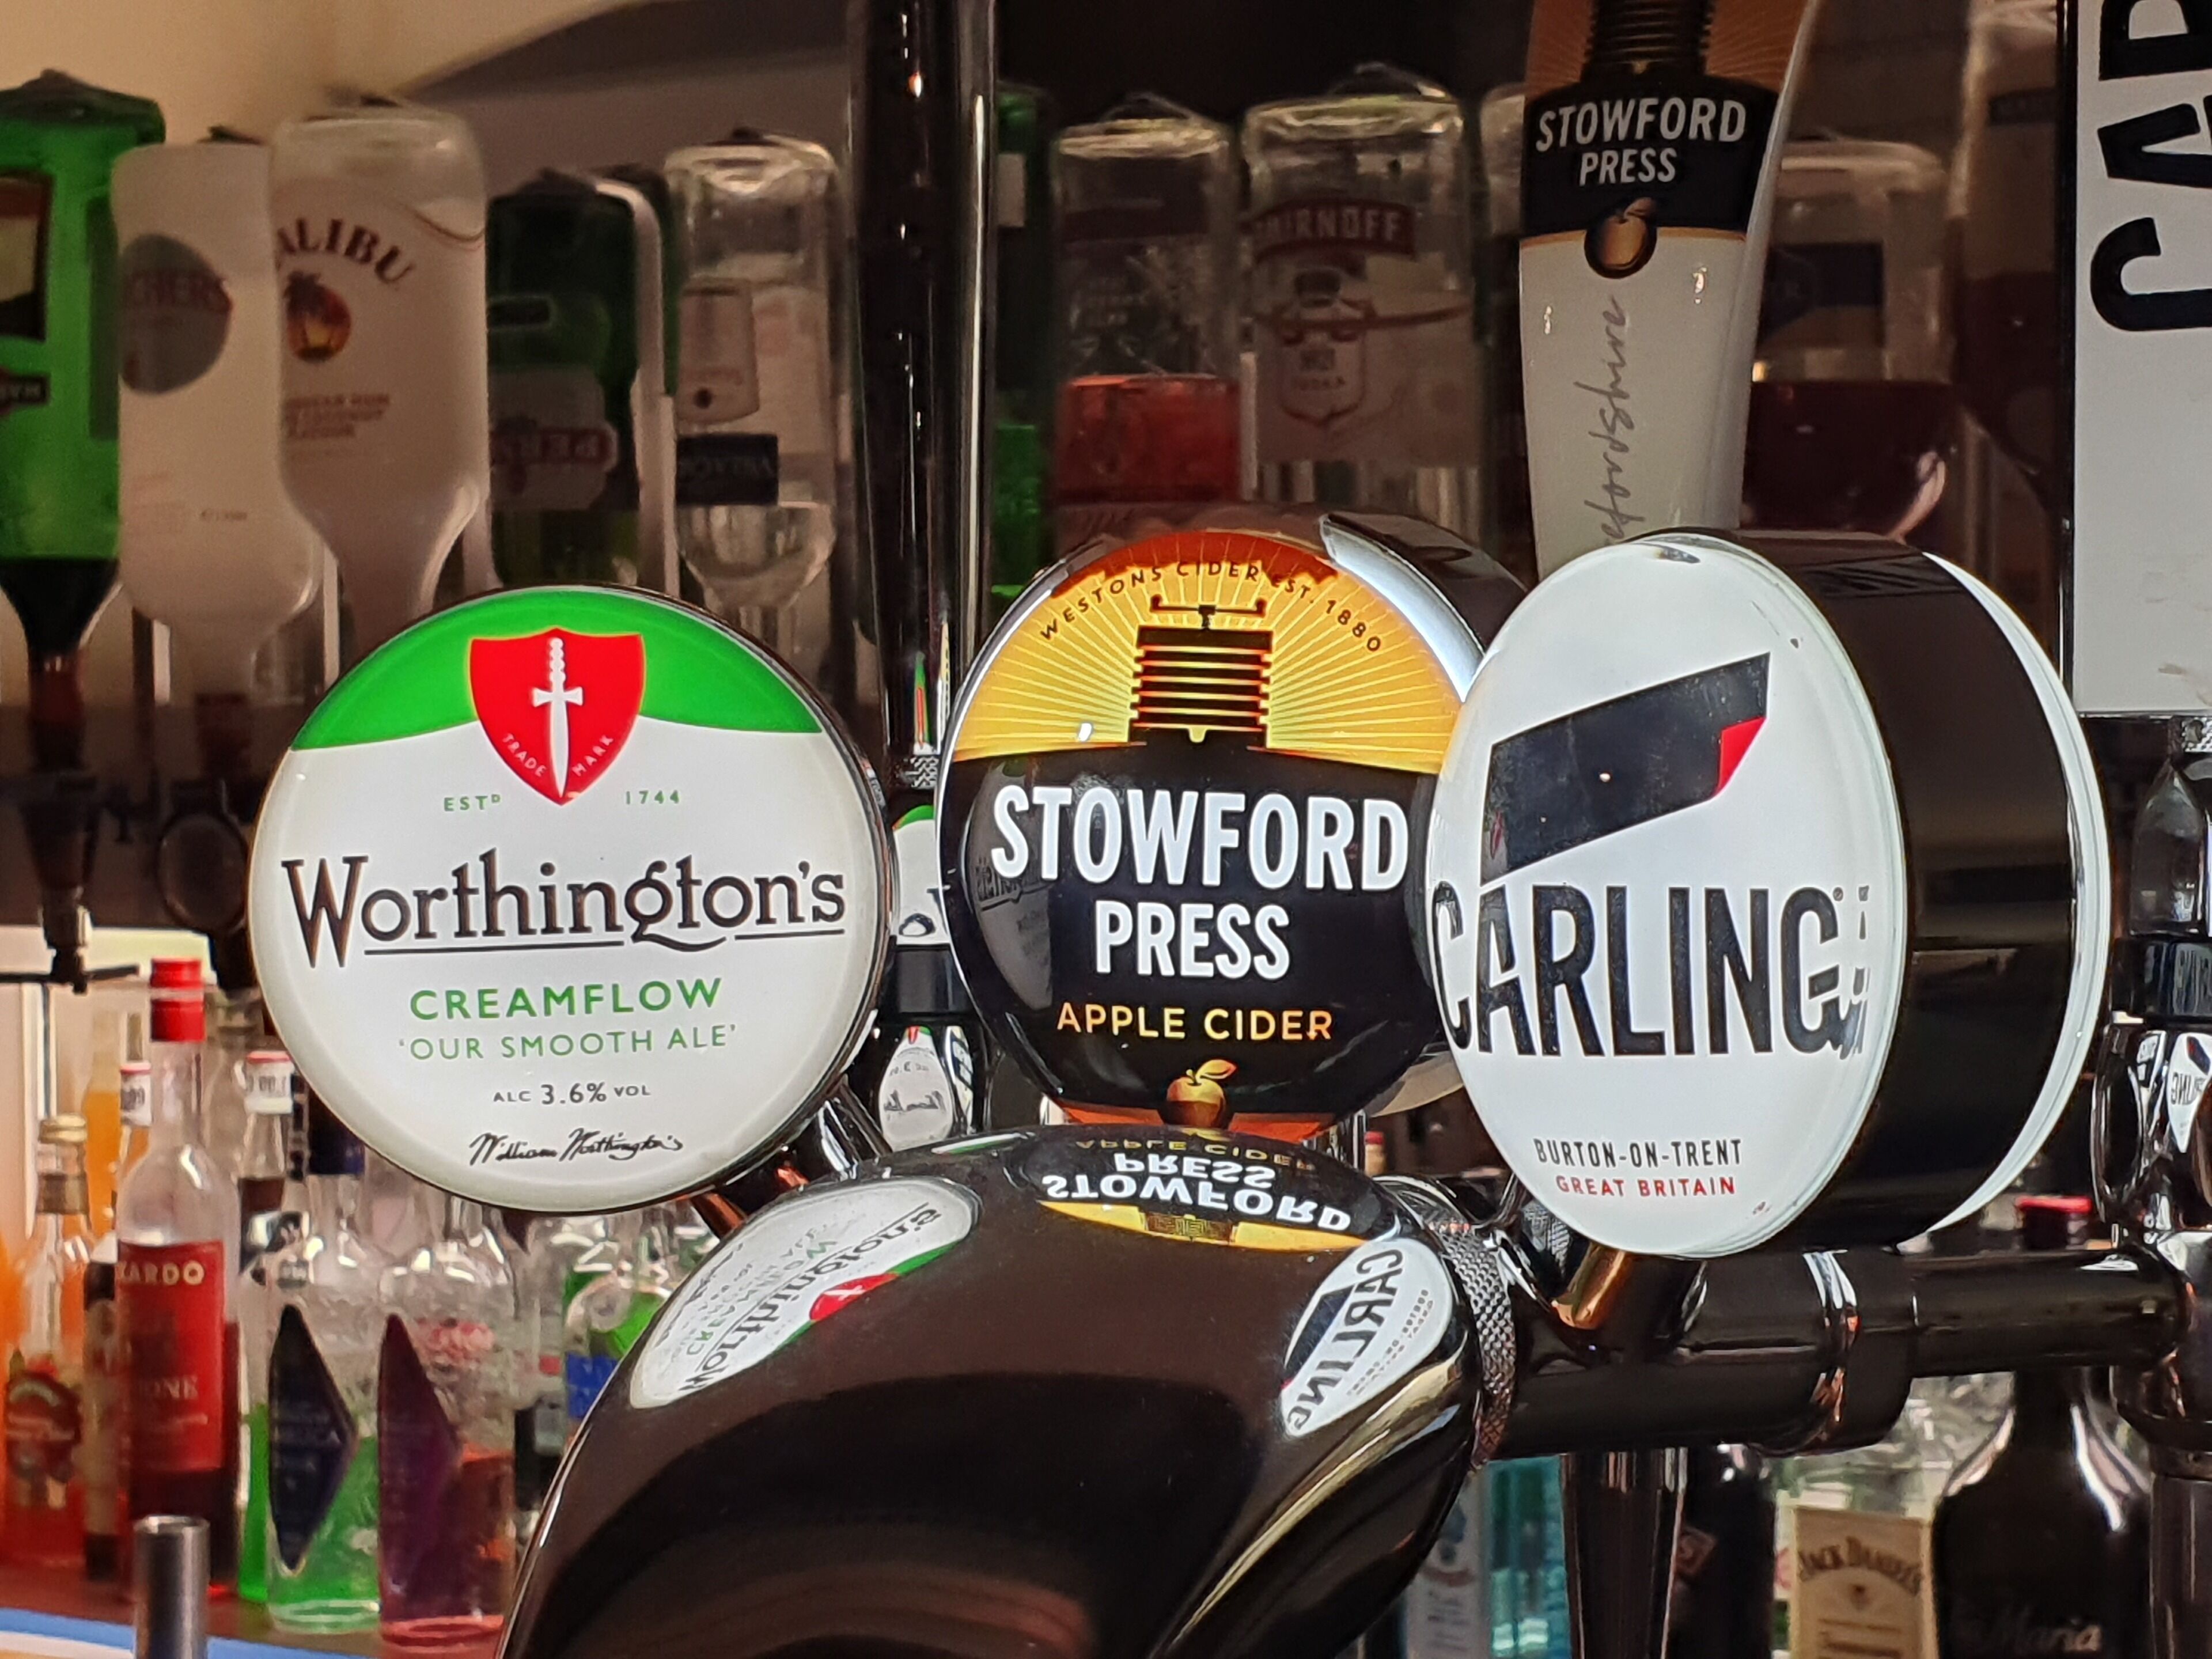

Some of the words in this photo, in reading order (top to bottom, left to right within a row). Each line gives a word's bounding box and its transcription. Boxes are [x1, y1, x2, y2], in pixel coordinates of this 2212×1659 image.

[1536, 97, 1746, 151] STOWFORD
[1580, 147, 1677, 186] PRESS
[1574, 295, 1646, 544] efordshire
[1040, 566, 1162, 641] WESTONS
[1176, 562, 1260, 582] CIDER
[1271, 577, 1315, 604] EST.
[1325, 600, 1382, 652] 1880
[502, 733, 547, 778] TRADE
[571, 734, 614, 777] MARK
[626, 789, 680, 805] 1744
[990, 784, 1409, 891] STOWFORD
[281, 847, 846, 969] Worthington's
[1094, 900, 1290, 980] PRESS
[1432, 881, 1852, 1058] CARLING
[410, 978, 722, 1021] CREAMFLOW
[1056, 1002, 1185, 1039] APPLE
[1204, 1009, 1334, 1041] CIDER
[398, 1037, 484, 1060] 'OUR
[501, 1030, 653, 1058] SMOOTH
[666, 1024, 737, 1050] ALE'
[493, 1090, 532, 1103] ALC
[540, 1081, 607, 1105] 3.6%
[613, 1084, 652, 1097] VOL
[1533, 1138, 1741, 1168] BURTON-ON-TRENT
[1555, 1175, 1625, 1197] GREAT
[1637, 1176, 1735, 1197] BRITAIN
